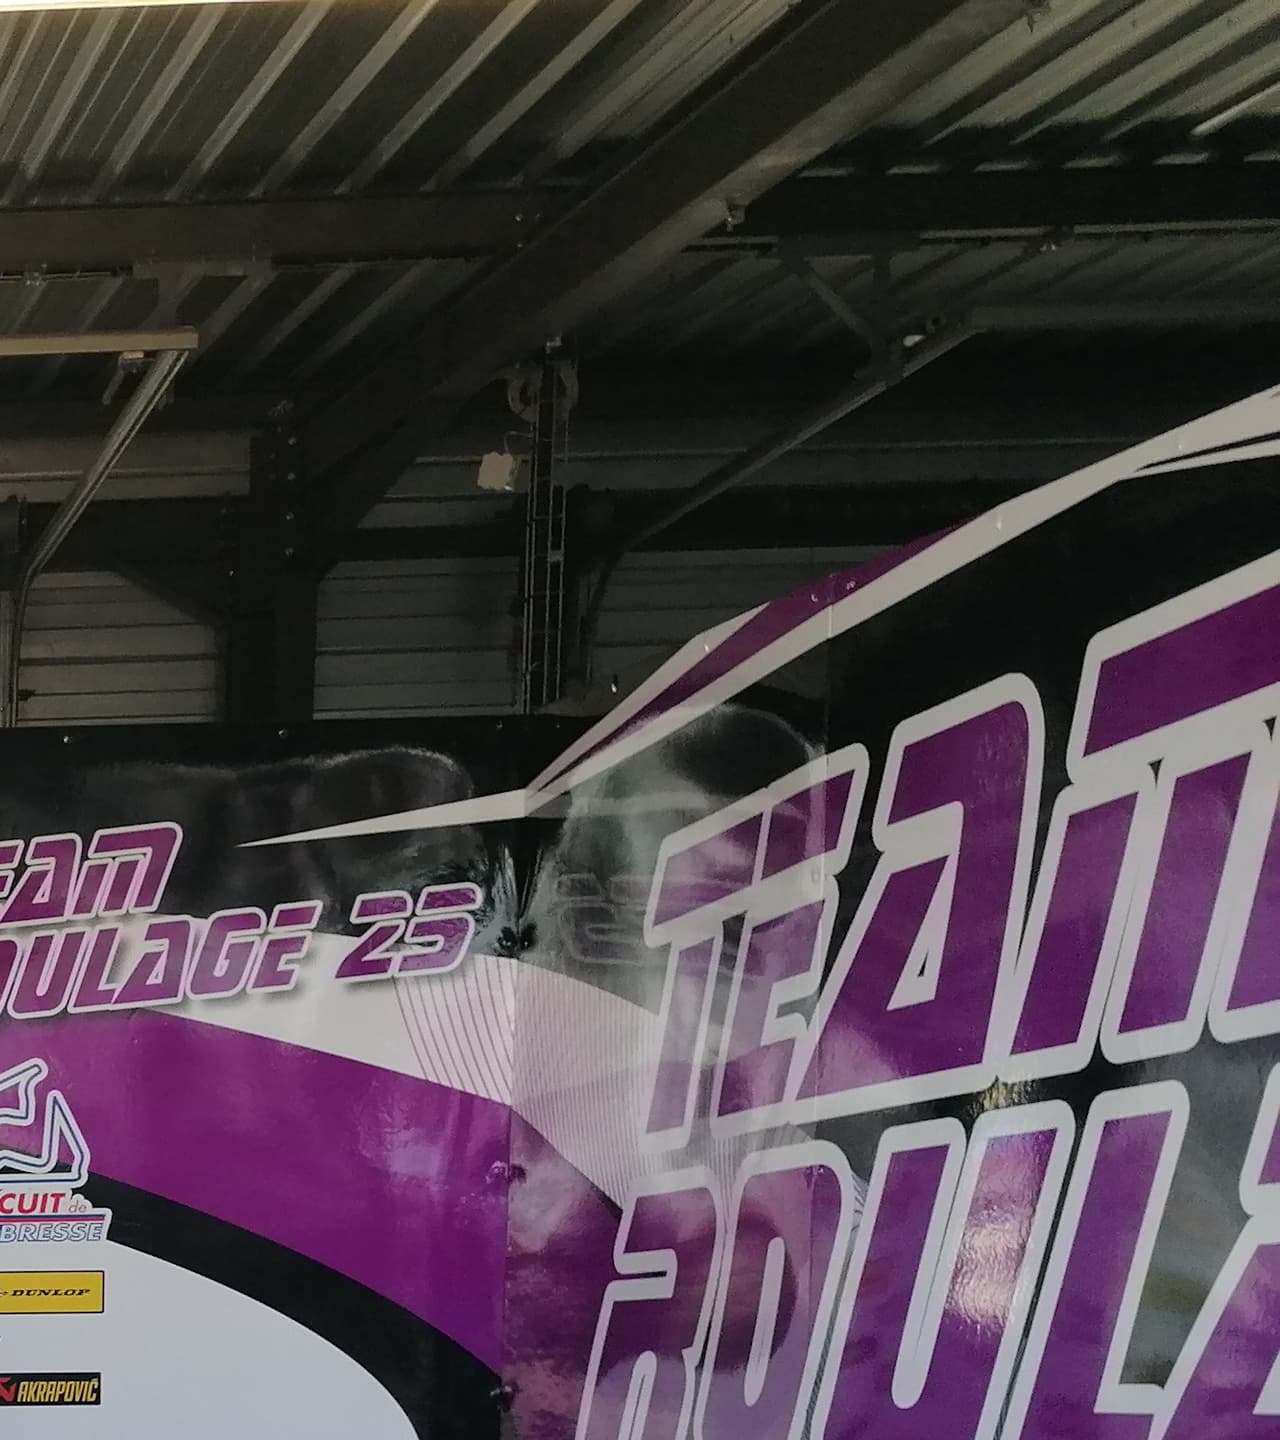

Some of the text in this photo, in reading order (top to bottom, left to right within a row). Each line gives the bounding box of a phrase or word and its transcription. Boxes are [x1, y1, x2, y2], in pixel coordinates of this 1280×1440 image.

[333, 881, 482, 983] 25
[68, 1199, 88, 1214] de
[10, 1288, 91, 1298] DUNLOP
